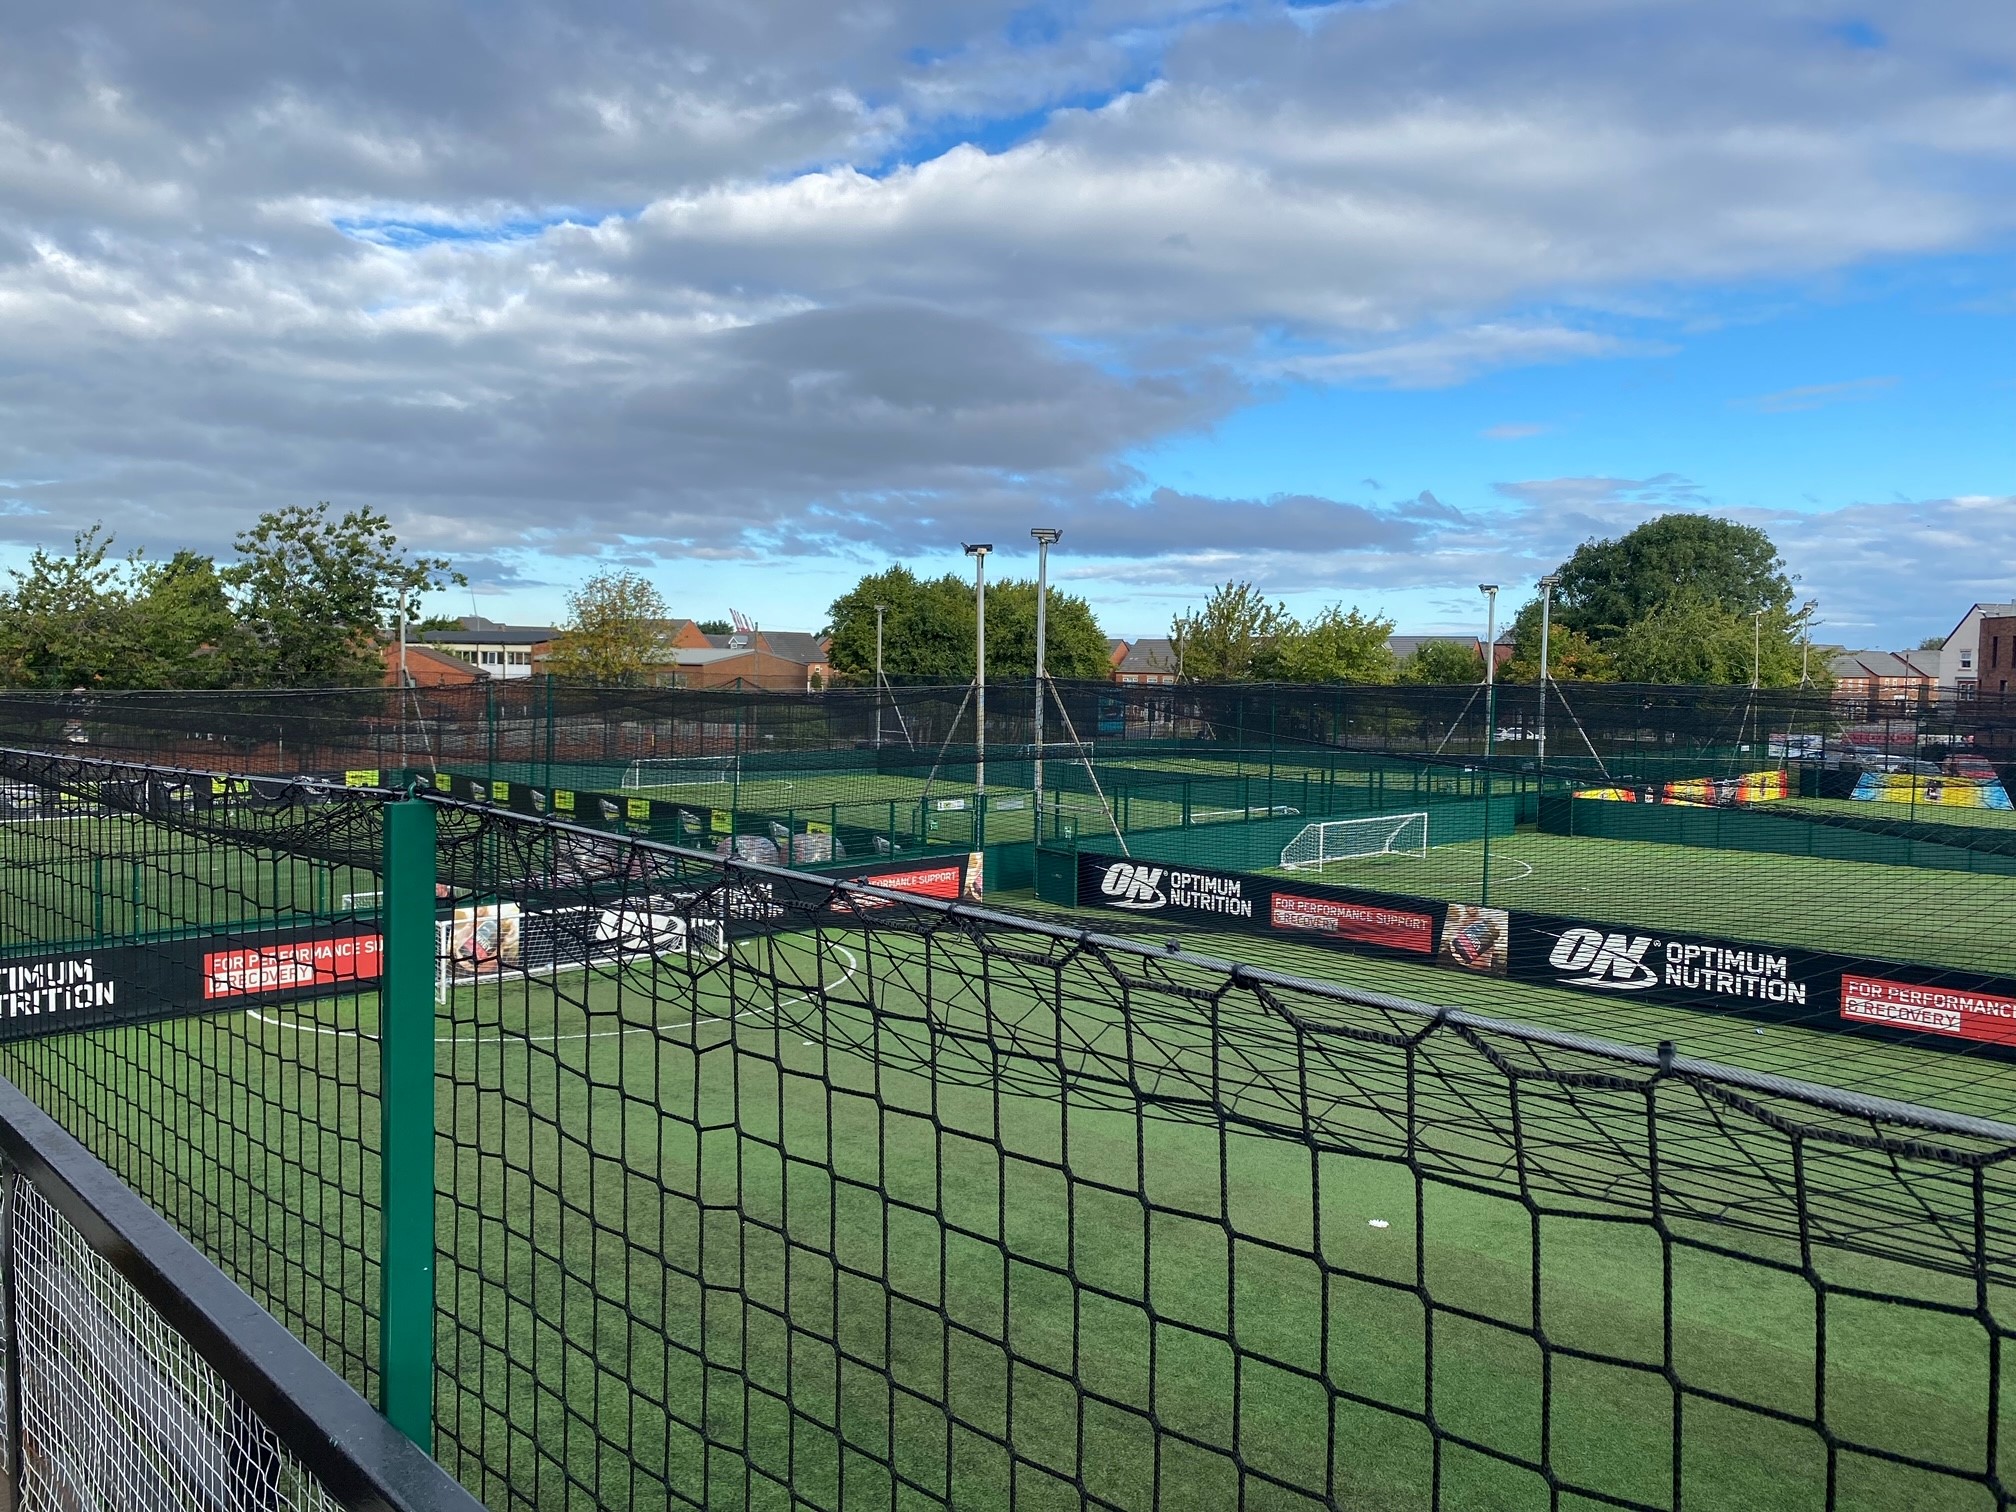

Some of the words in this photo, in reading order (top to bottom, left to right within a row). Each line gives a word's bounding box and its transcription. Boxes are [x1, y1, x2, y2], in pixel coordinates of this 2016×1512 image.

[919, 871, 957, 885] SUPPORT
[1101, 863, 1163, 901] ON
[1170, 872, 1241, 898] OPTIMUM
[1170, 888, 1252, 918] NUTRITION
[1275, 898, 1295, 911] FOR
[1297, 902, 1373, 922] PERFORMANCE
[1376, 913, 1428, 931] SUPPORT
[213, 958, 244, 972] FOR
[249, 942, 361, 969] PERFORMANCE
[1548, 928, 1652, 980] ON
[1665, 941, 1787, 979] OPTIMUM
[230, 966, 309, 987] RECOVERY
[1665, 963, 1806, 1006] NUTRITION
[1848, 981, 1882, 998] FOR
[1864, 1002, 1957, 1026] RECOVERY
